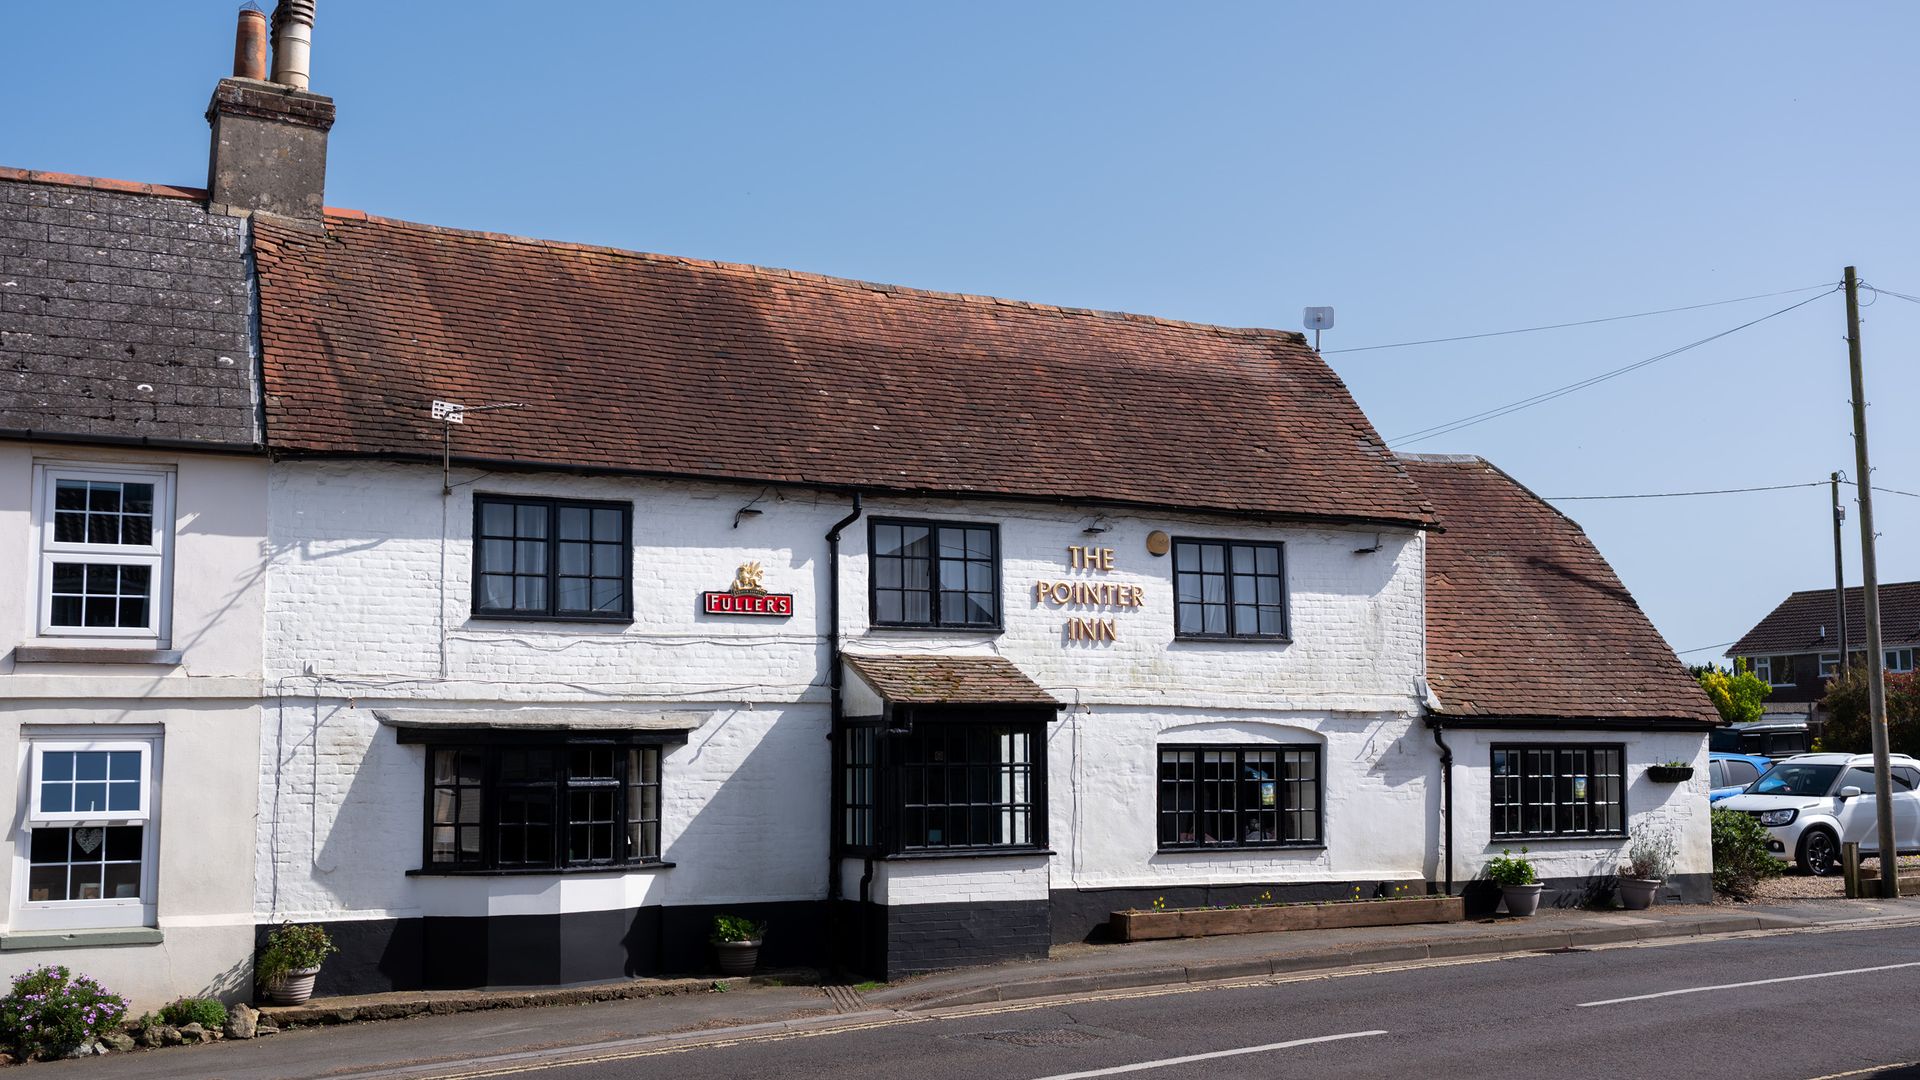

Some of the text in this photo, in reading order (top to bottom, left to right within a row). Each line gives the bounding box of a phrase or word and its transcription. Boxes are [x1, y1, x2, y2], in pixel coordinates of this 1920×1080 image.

[1068, 546, 1114, 570] THE
[711, 595, 787, 612] FULLER'S
[1036, 580, 1144, 607] POINTER
[1067, 617, 1117, 642] INN
